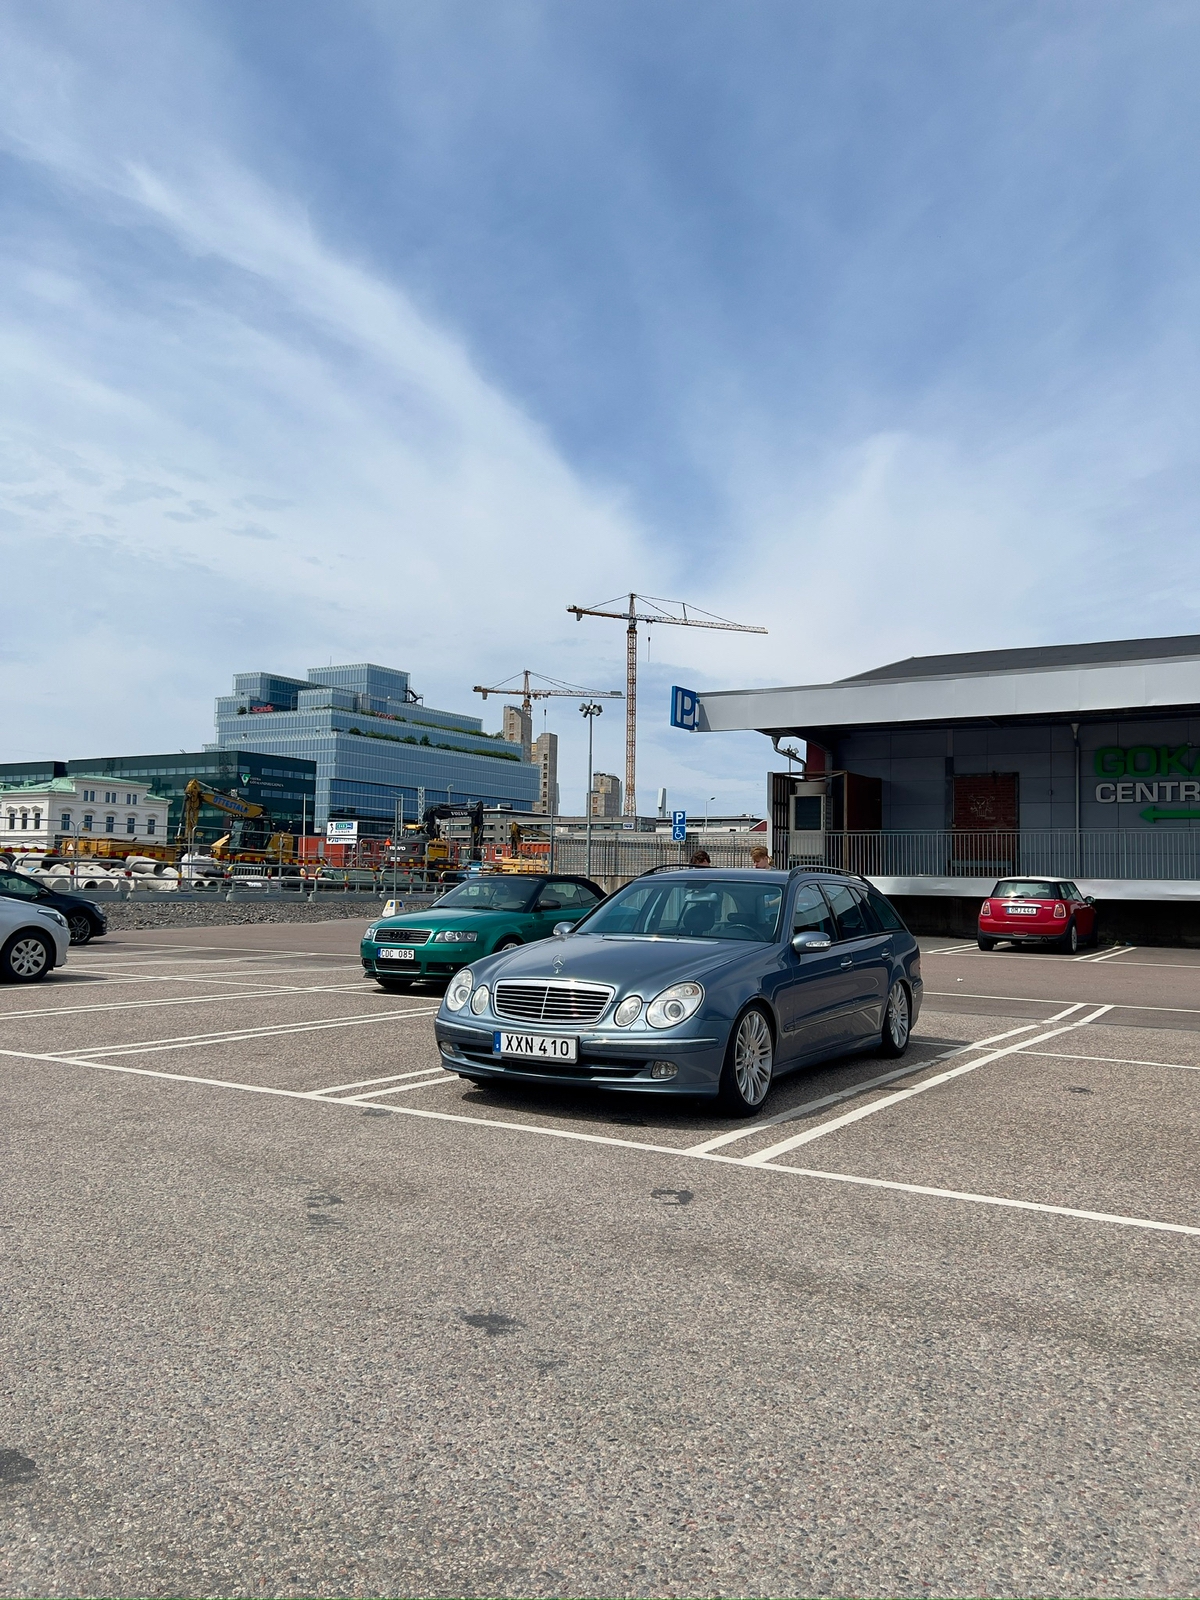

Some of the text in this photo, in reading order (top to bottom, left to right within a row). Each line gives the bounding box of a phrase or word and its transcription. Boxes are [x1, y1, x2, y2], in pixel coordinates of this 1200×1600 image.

[1095, 781, 1200, 803] CENTR
[676, 812, 684, 824] P
[381, 949, 413, 959] CDC 085
[505, 1034, 534, 1053] XXN
[538, 1038, 569, 1056] 410
